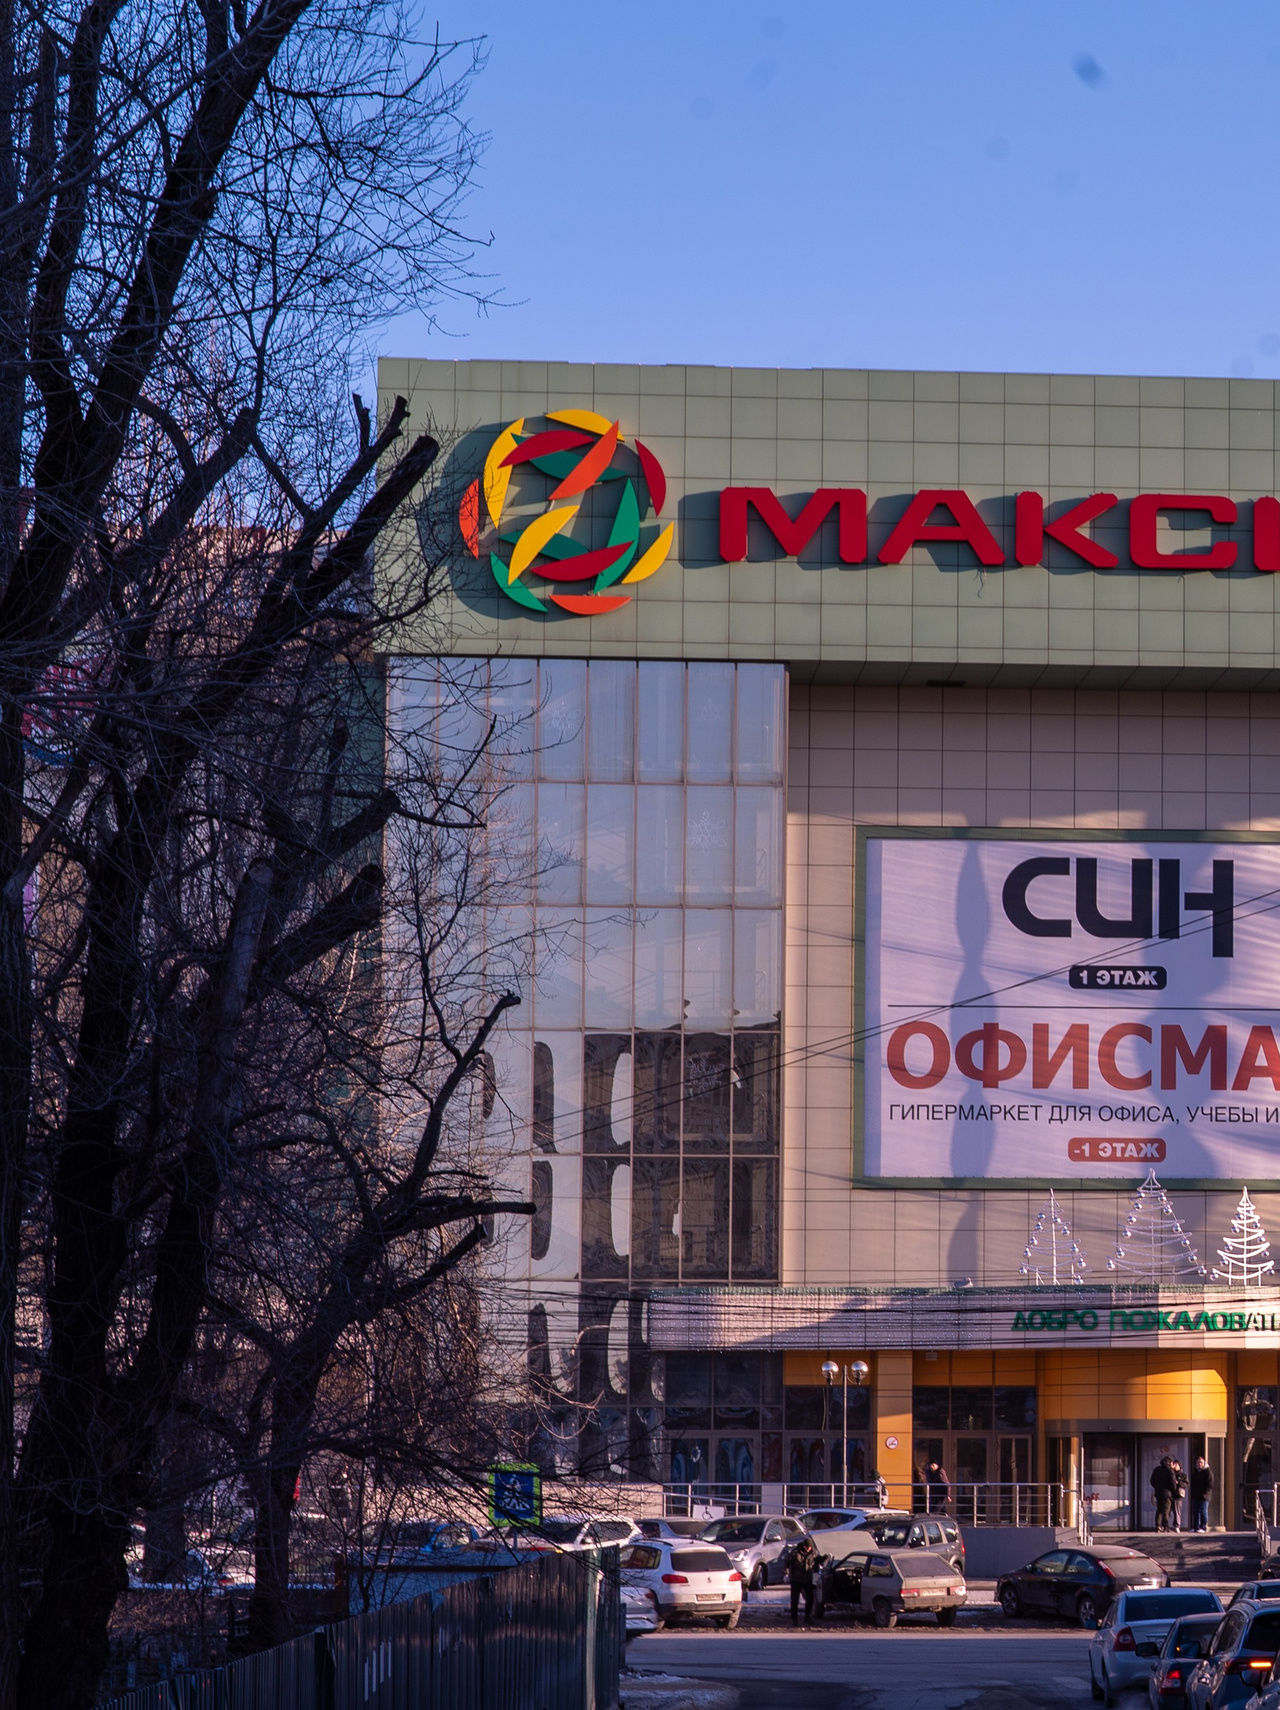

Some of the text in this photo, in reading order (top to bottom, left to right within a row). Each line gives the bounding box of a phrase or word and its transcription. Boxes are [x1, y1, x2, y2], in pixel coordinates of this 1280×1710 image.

[1079, 970, 1158, 986] 1 ЭТАЖ
[889, 1104, 1043, 1123] ГИПЕРМАРКЕТ
[1048, 1105, 1092, 1124] ДЛЯ
[1097, 1105, 1181, 1125] ОФИСА,
[1186, 1106, 1260, 1124] УЧЕБЫ
[1265, 1107, 1279, 1124] И
[1073, 1142, 1160, 1158] -1 ЭТАЖ
[1011, 1310, 1099, 1332] ДОБРО
